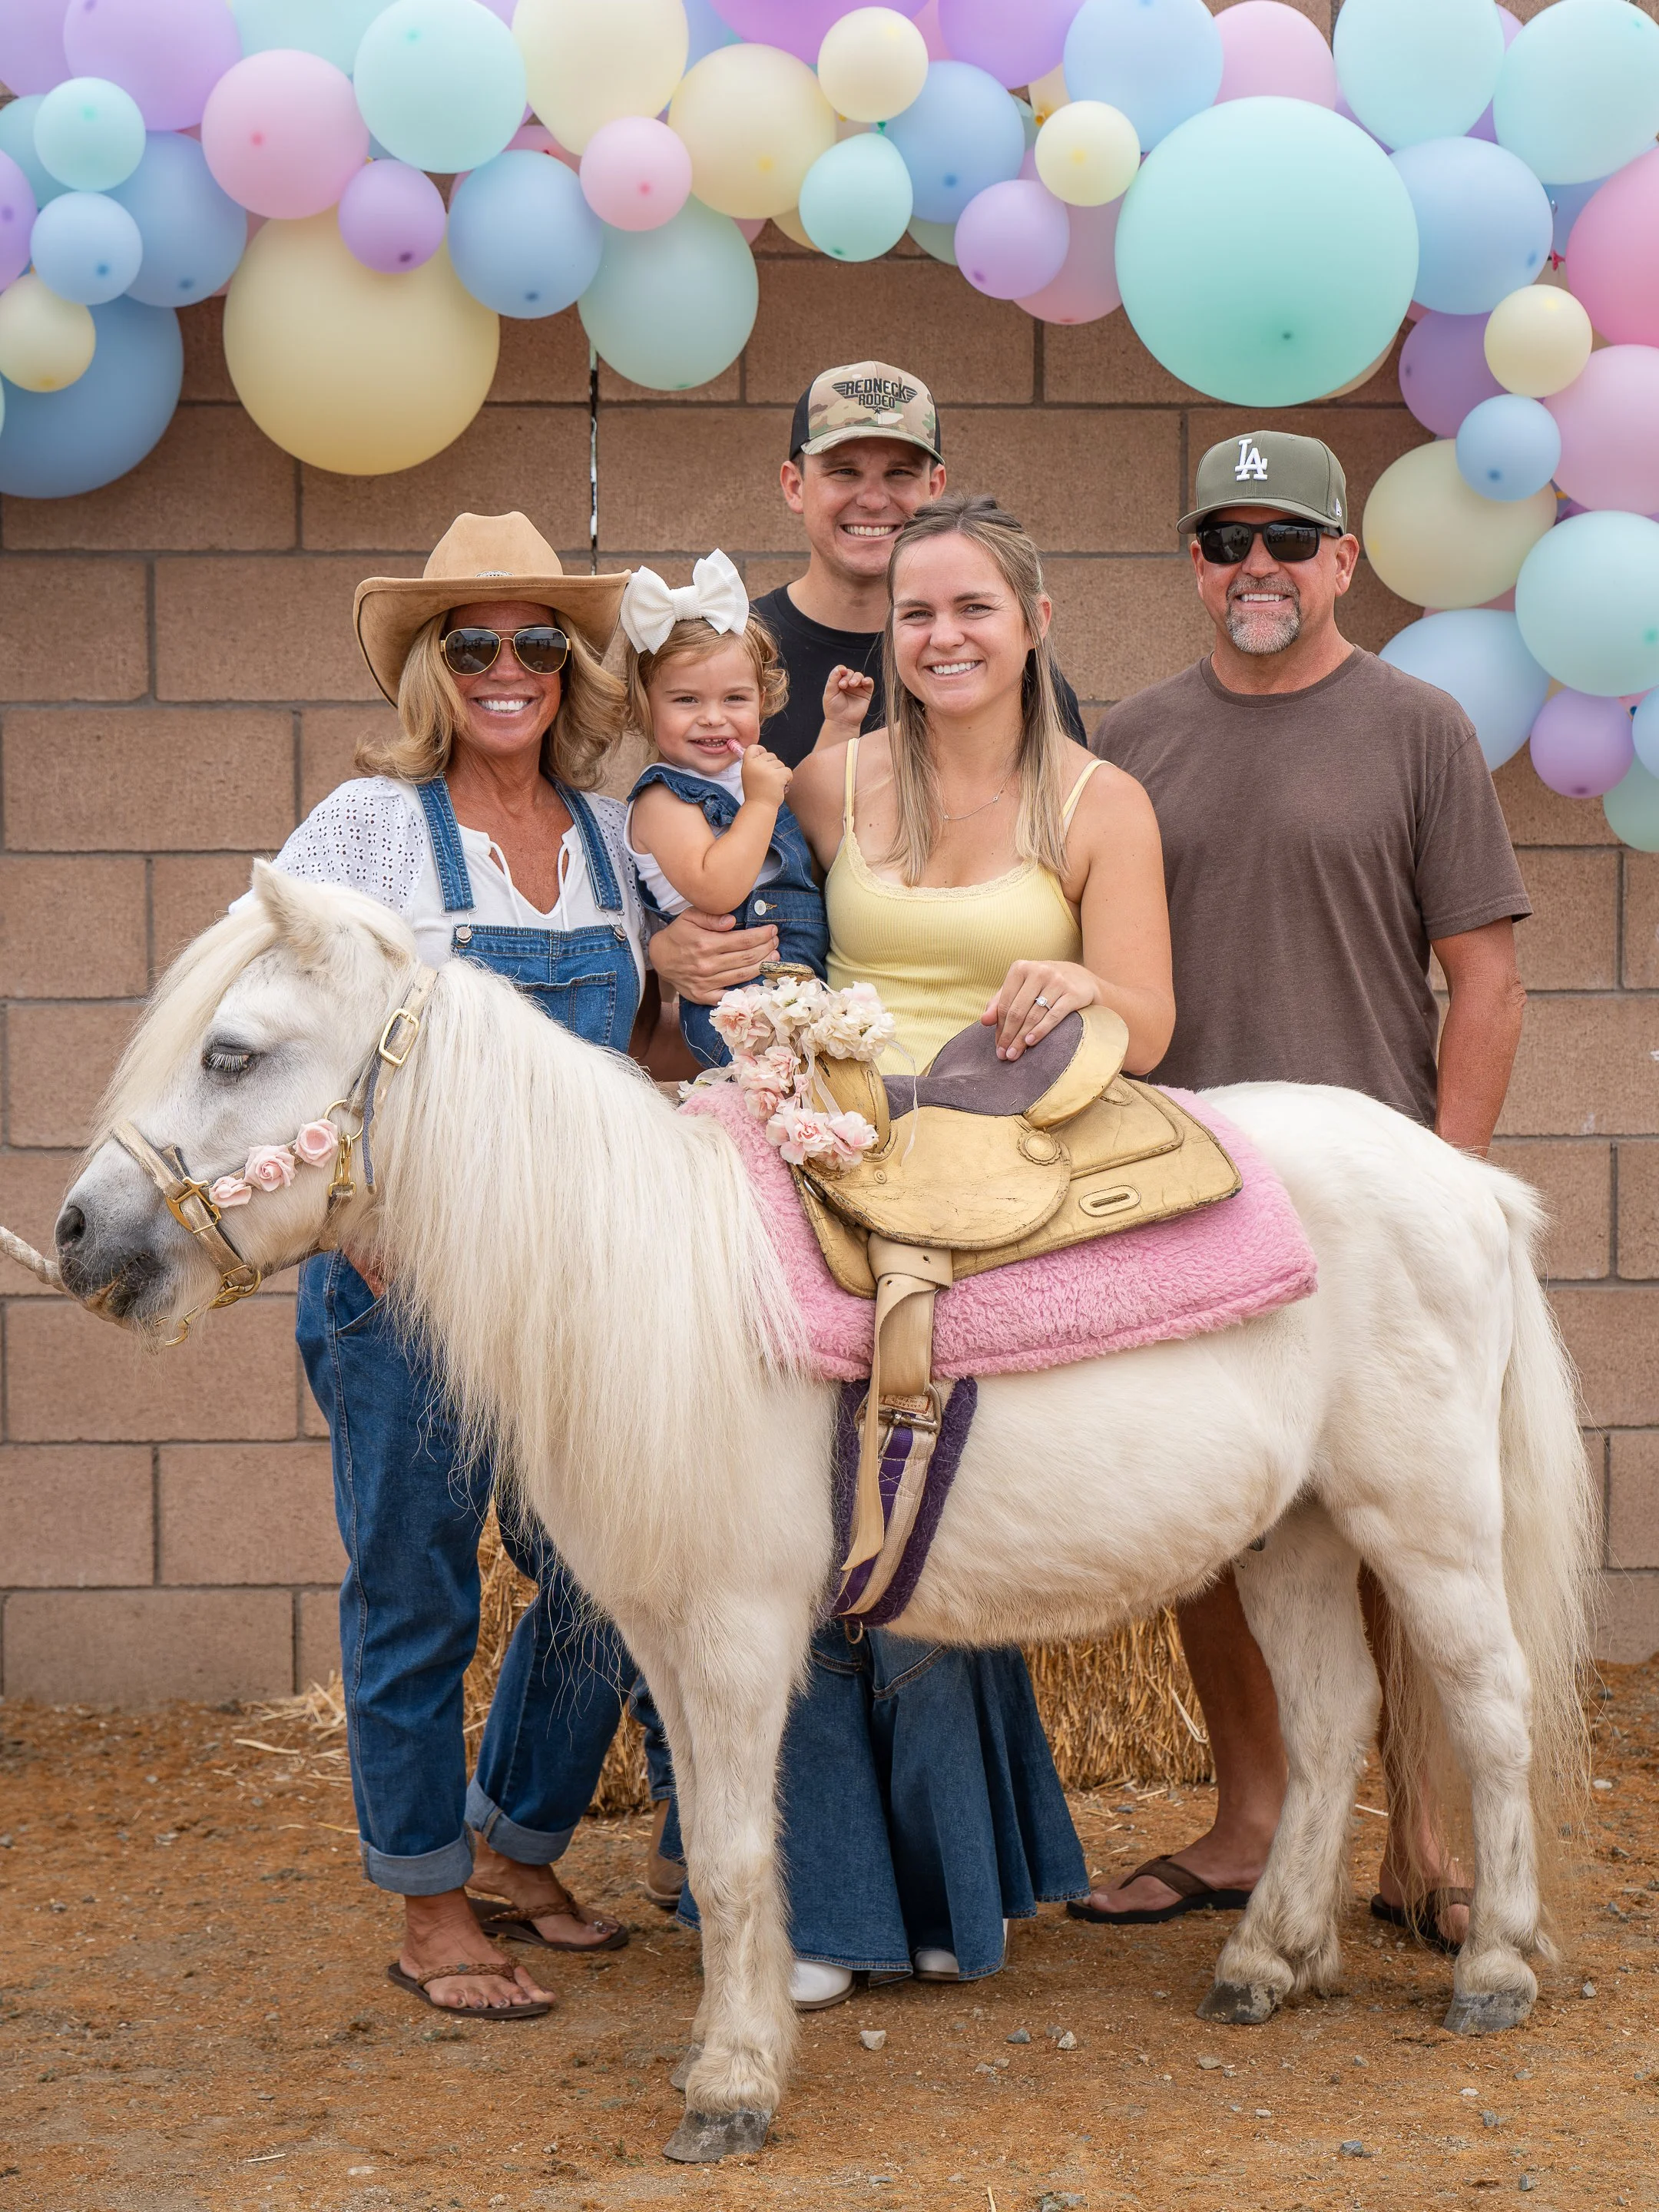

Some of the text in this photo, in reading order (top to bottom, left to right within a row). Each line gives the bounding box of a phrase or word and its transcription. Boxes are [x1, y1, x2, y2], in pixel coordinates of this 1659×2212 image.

[846, 378, 908, 399] REDNECK
[859, 393, 895, 409] RODEO
[1235, 439, 1268, 482] LA
